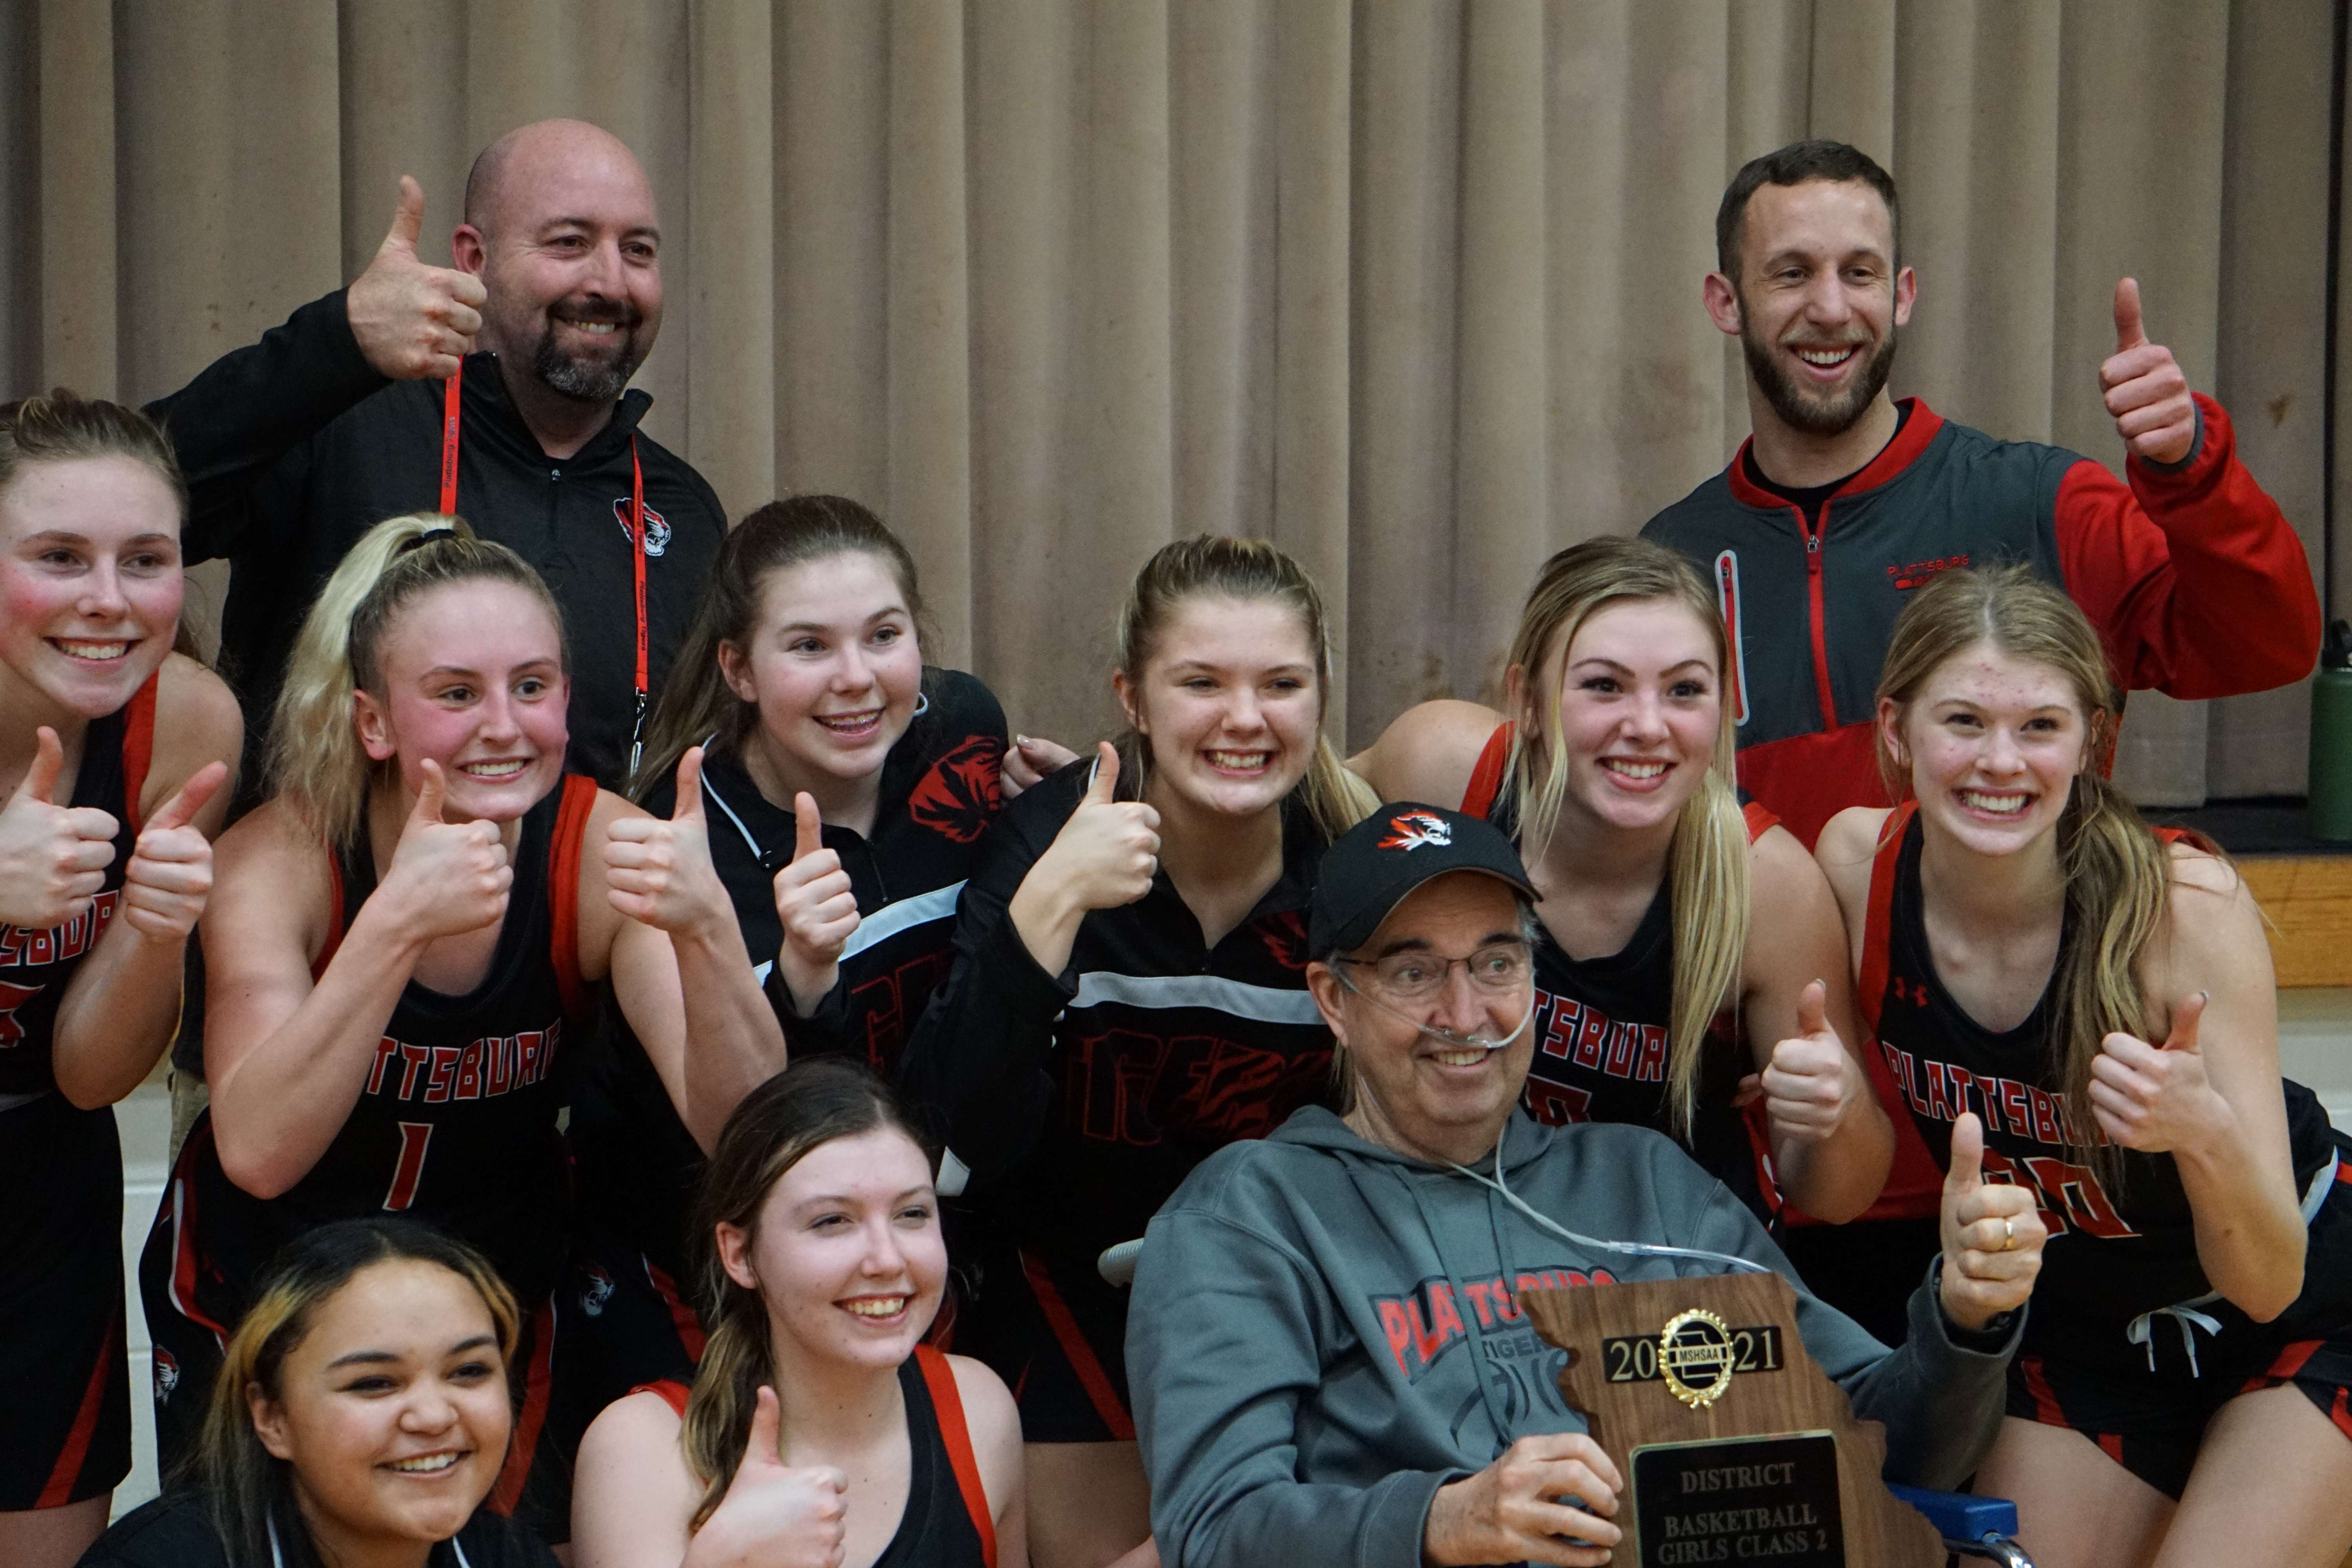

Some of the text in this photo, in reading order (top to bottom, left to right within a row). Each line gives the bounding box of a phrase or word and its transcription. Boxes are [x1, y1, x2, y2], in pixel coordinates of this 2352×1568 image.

[382, 1121, 434, 1211] 1
[1610, 1329, 1777, 1381] 20 21
[1679, 1347, 1719, 1363] MSHSAA
[1681, 1462, 1795, 1494] DISTRICT
[1664, 1504, 1817, 1538] BASKETBALL
[1658, 1528, 1828, 1566] GIRLS CLASS 2
